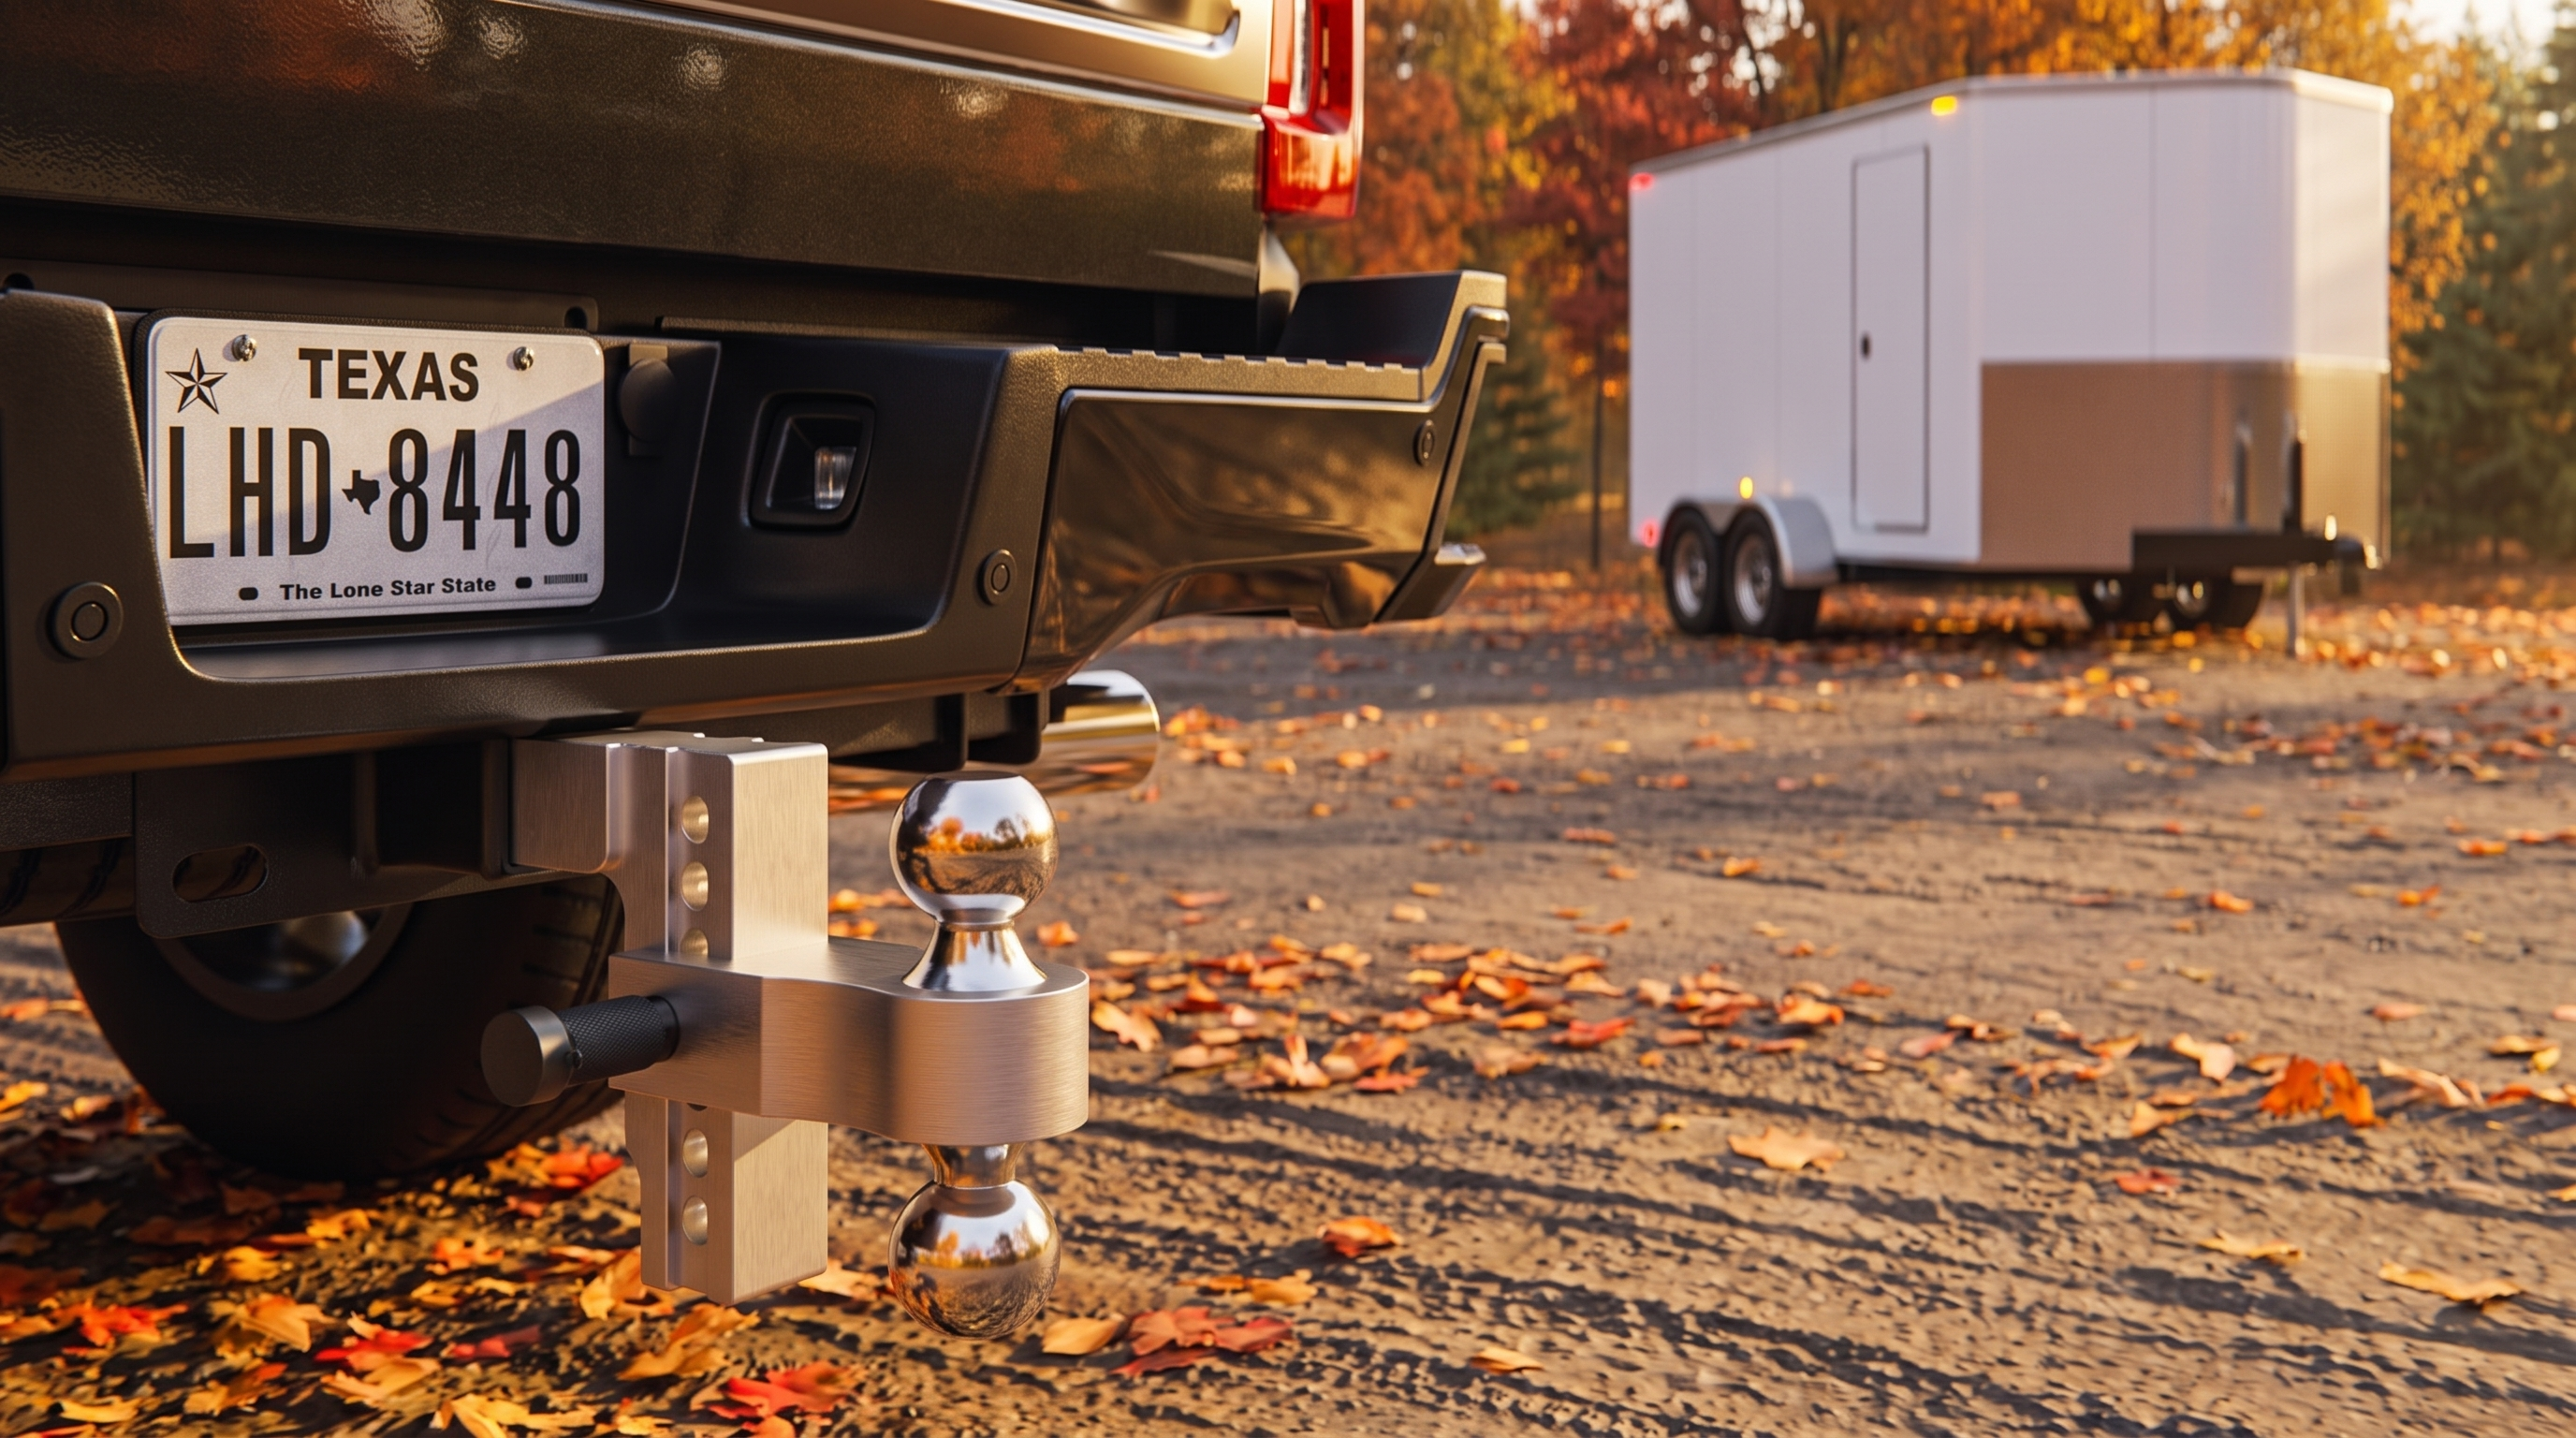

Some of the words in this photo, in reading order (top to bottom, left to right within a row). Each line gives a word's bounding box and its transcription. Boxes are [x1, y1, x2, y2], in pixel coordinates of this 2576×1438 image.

[298, 347, 479, 403] TEXAS
[168, 426, 331, 559] LHD
[388, 428, 581, 553] 8448
[279, 583, 323, 601] The
[330, 582, 384, 599] Lone
[390, 580, 436, 596] Star
[441, 577, 498, 594] State
